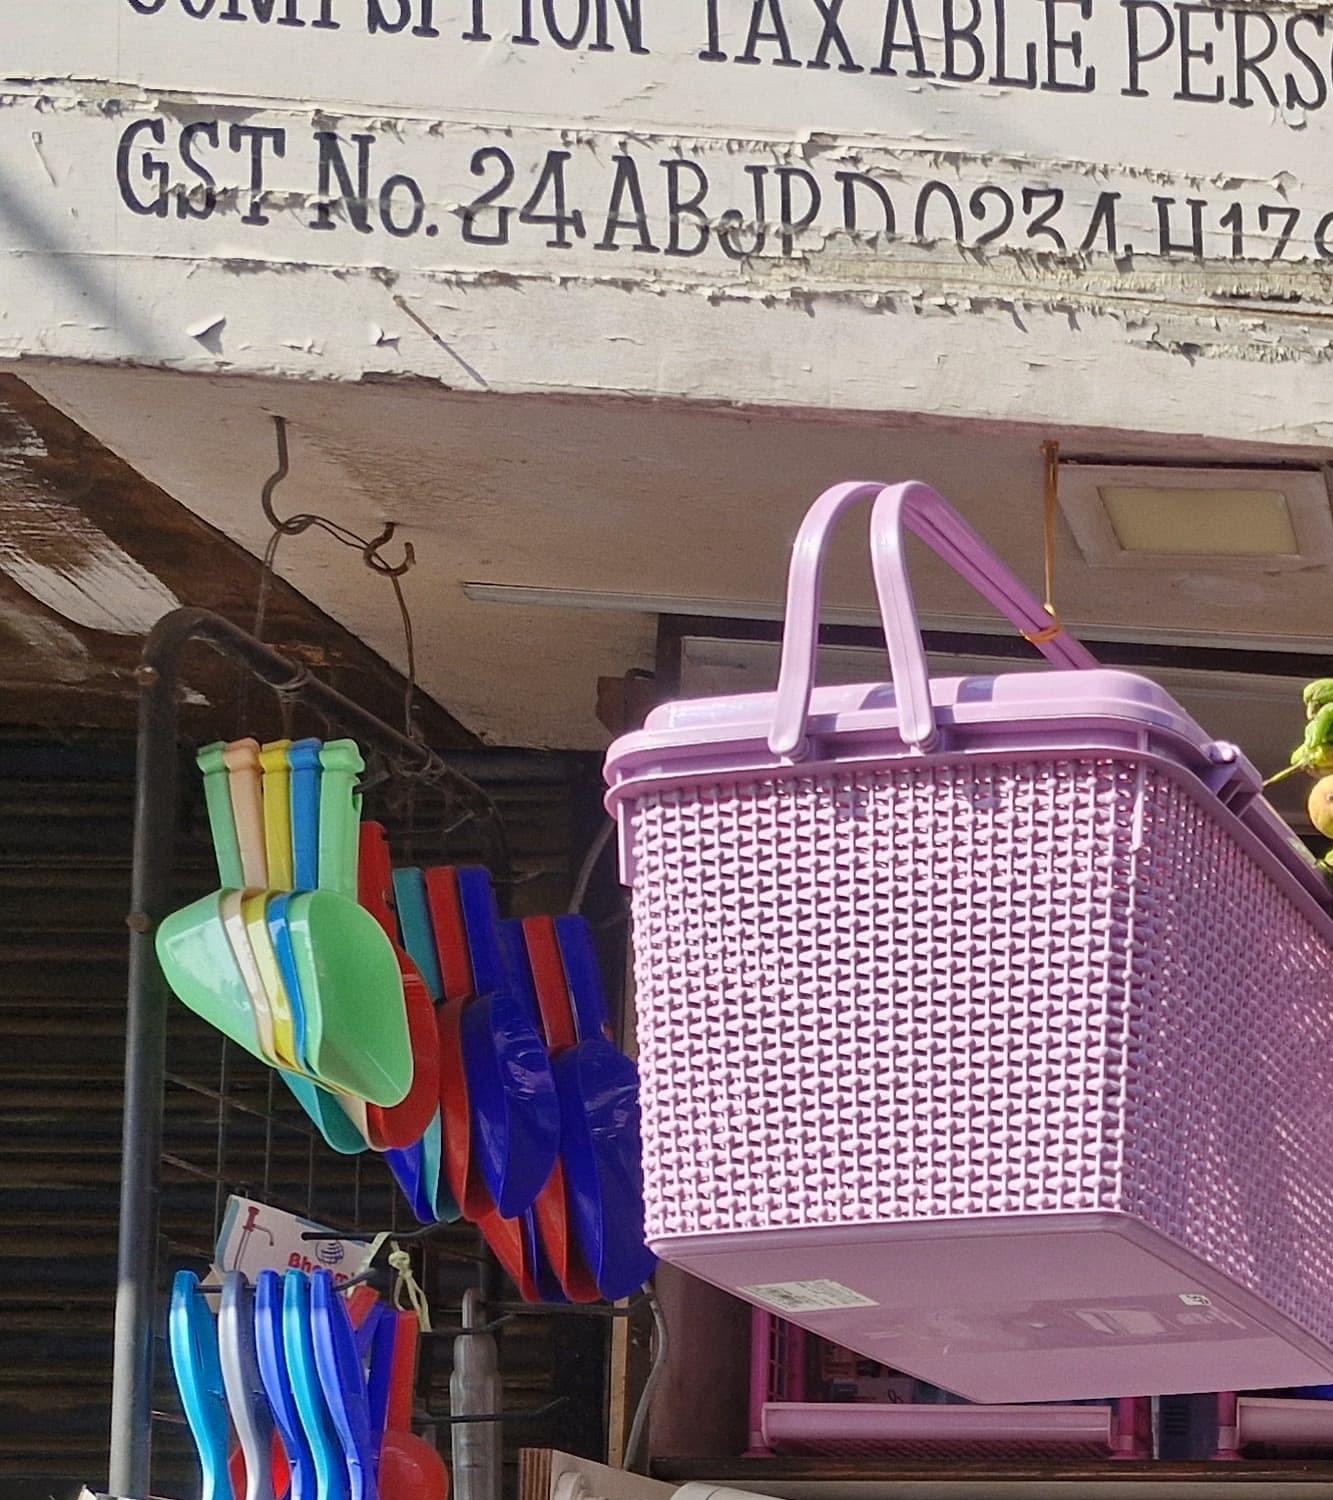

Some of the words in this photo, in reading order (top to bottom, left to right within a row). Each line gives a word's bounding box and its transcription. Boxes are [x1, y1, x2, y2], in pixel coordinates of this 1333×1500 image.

[699, 0, 1095, 92] TAXABLE
[116, 117, 285, 226] GST
[310, 130, 439, 239] No.
